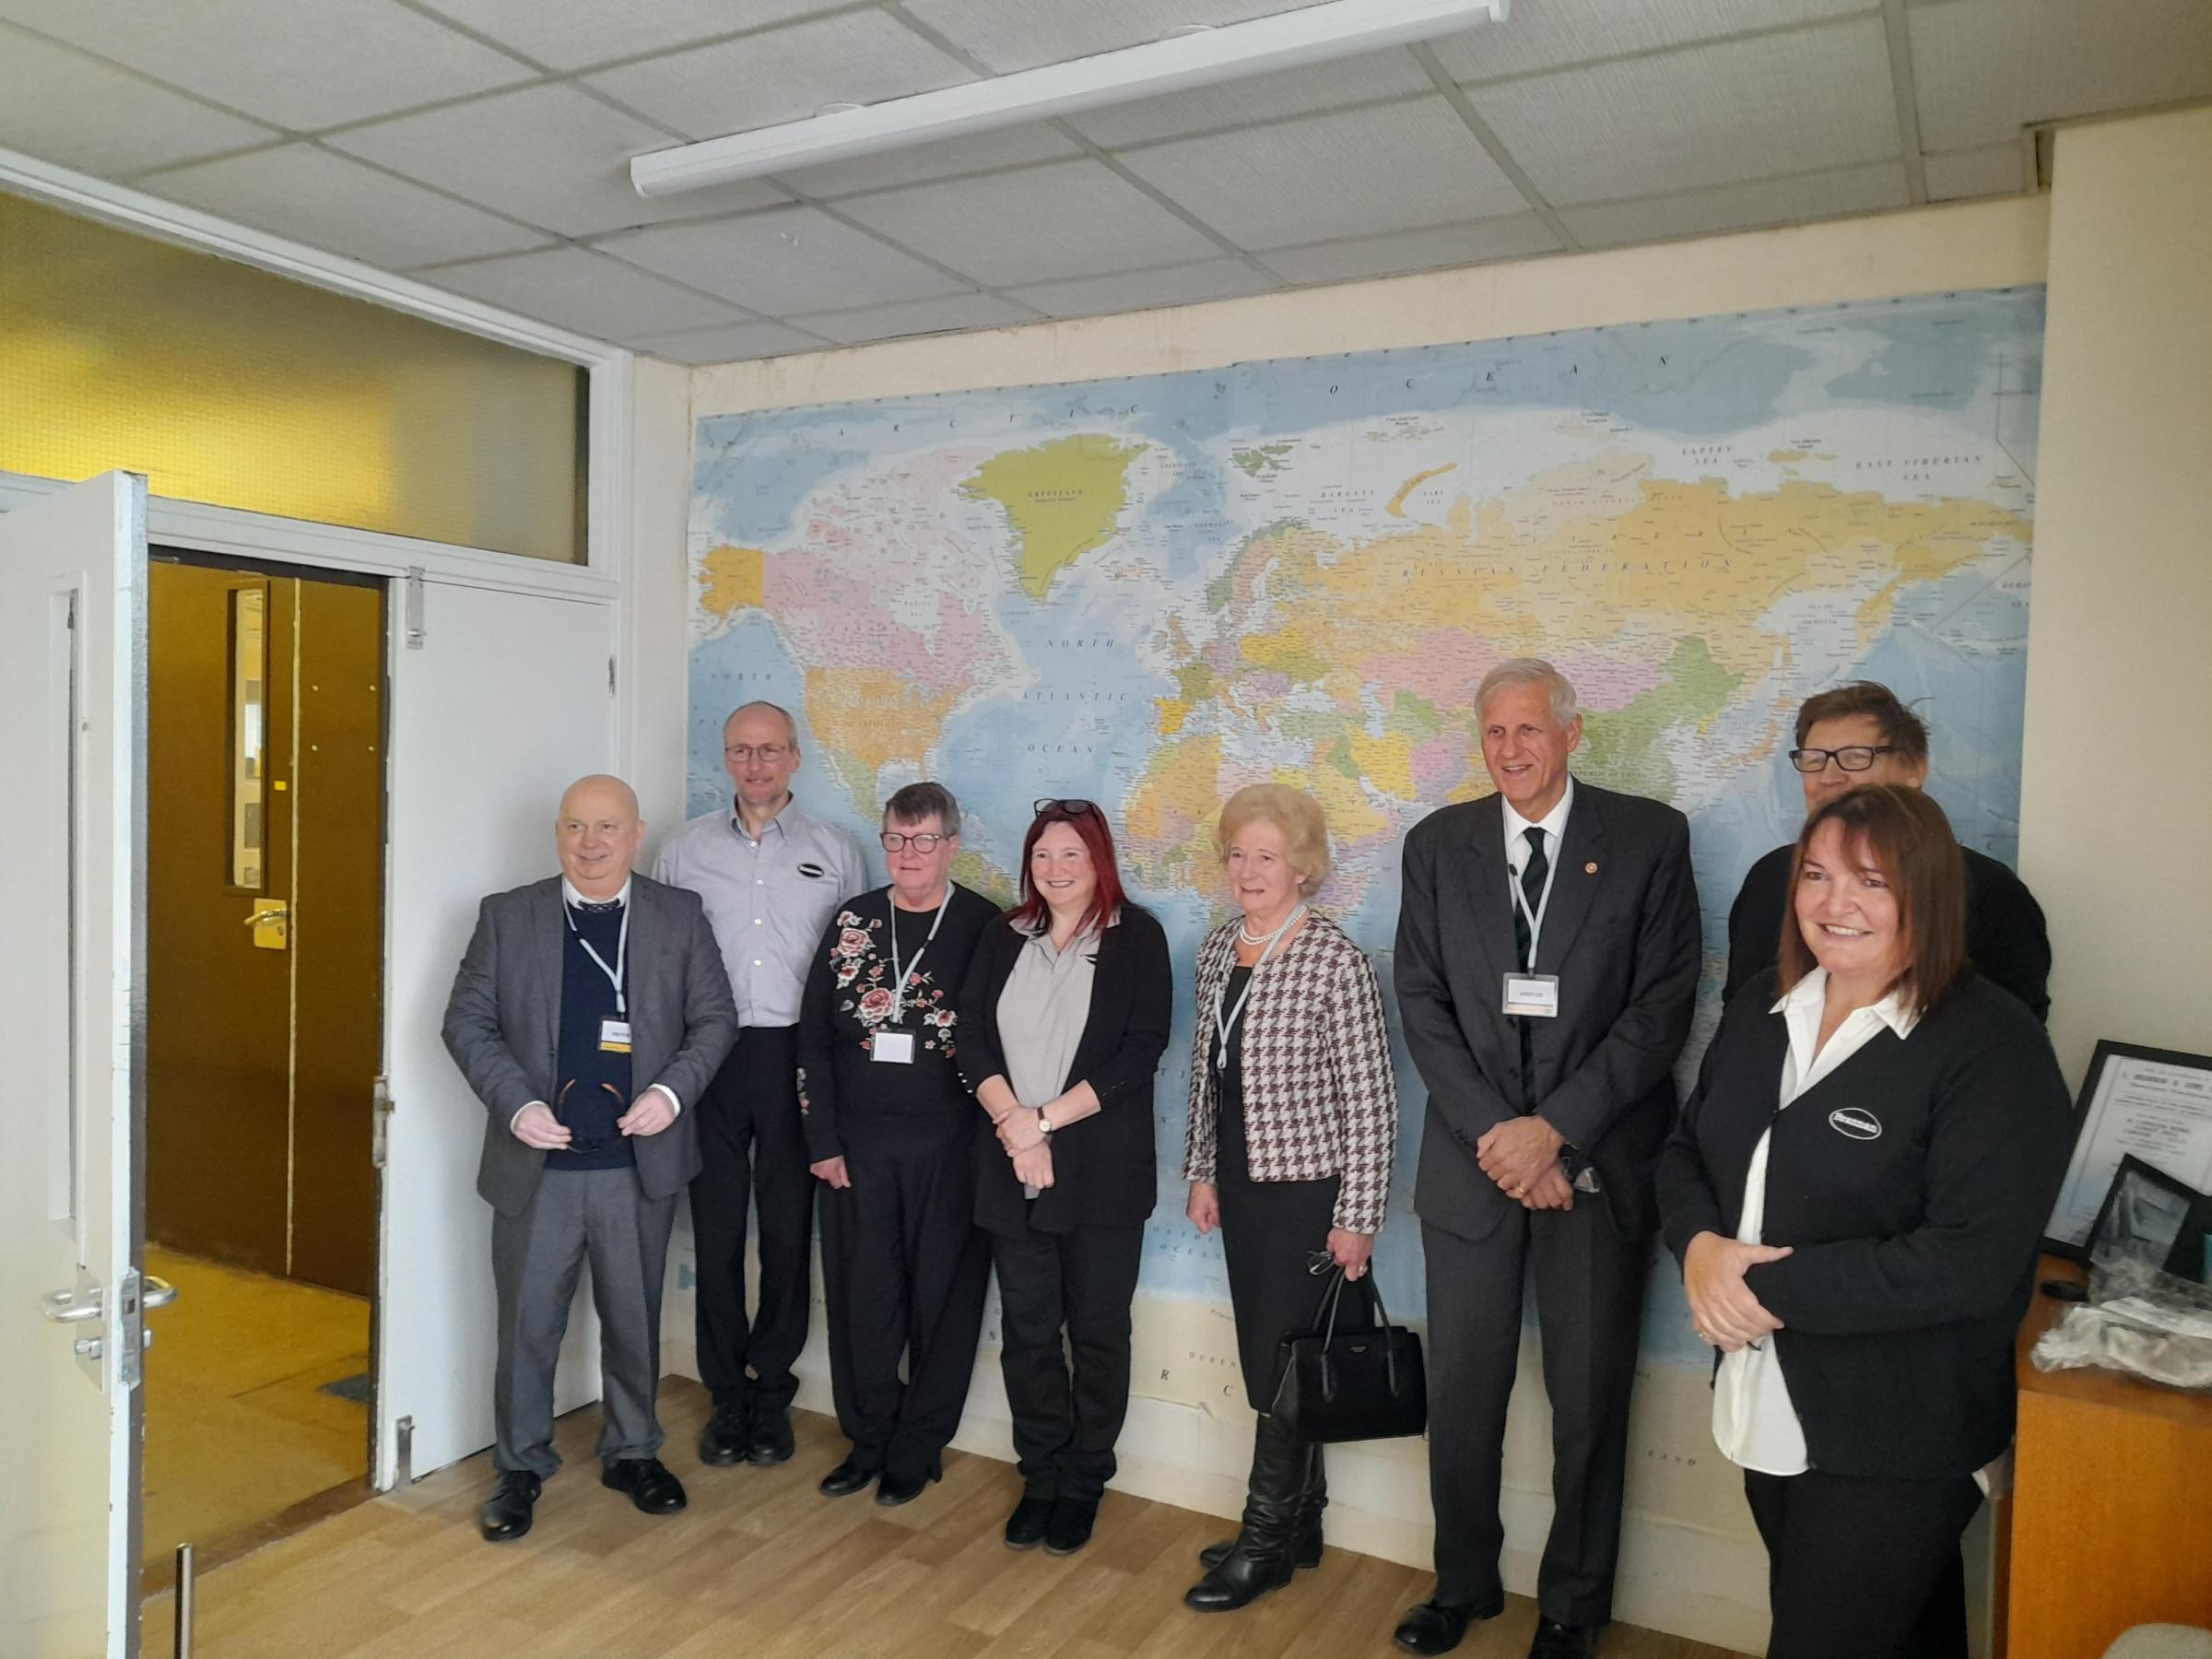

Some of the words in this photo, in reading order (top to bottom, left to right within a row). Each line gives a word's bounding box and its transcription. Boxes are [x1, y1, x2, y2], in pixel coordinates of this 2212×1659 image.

[837, 404, 1139, 438] ARCTIC
[1329, 355, 1668, 395] OCEAN
[1047, 640, 1115, 648] NORTH
[710, 673, 772, 681] NORTH
[1022, 692, 1129, 701] ATLANTIC
[1027, 744, 1095, 753] OCEAN
